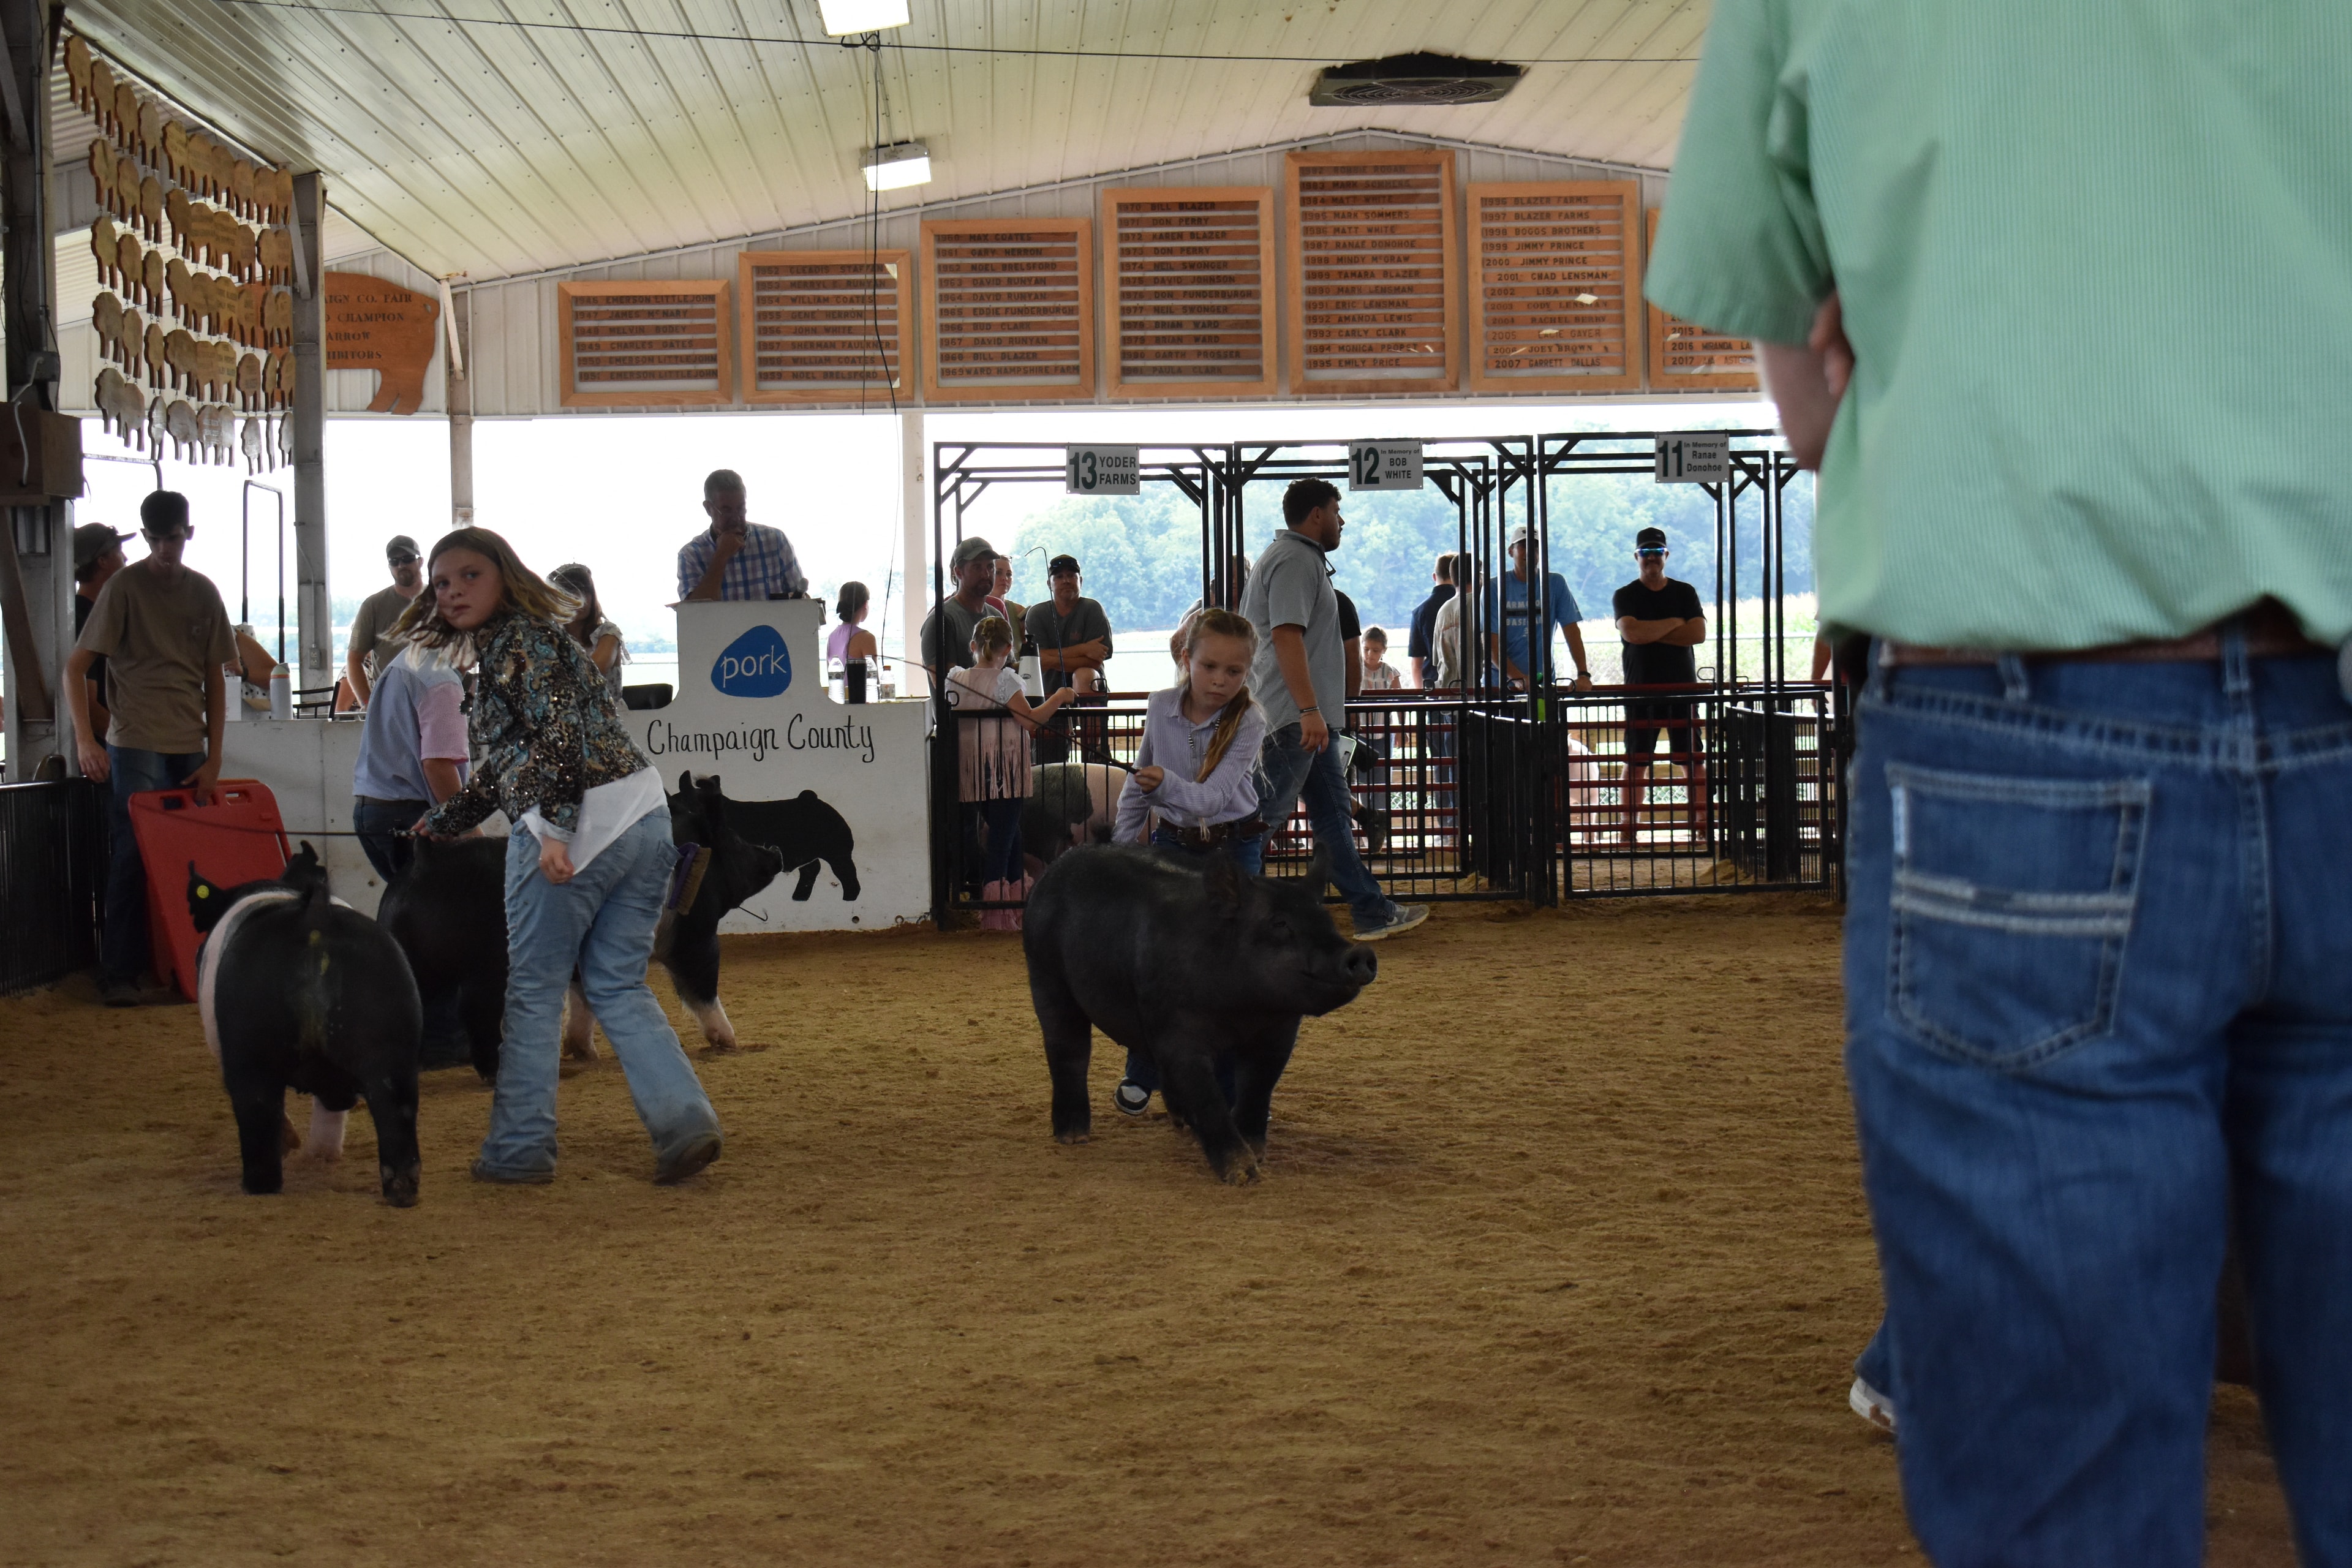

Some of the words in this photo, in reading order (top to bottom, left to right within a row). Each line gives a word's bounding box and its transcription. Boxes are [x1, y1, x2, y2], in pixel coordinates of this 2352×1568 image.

[384, 294, 412, 303] FAIR
[338, 313, 404, 322] CHAMPION
[327, 332, 370, 341] ARROW
[1099, 457, 1136, 467] YODER
[1658, 441, 1682, 477] 11
[1069, 451, 1097, 489] 13
[1352, 447, 1379, 484] 12
[1099, 473, 1136, 484] FARMS
[1385, 470, 1411, 479] WHITE
[720, 645, 786, 688] pork
[647, 719, 778, 761] Champaign
[788, 714, 874, 763] County
